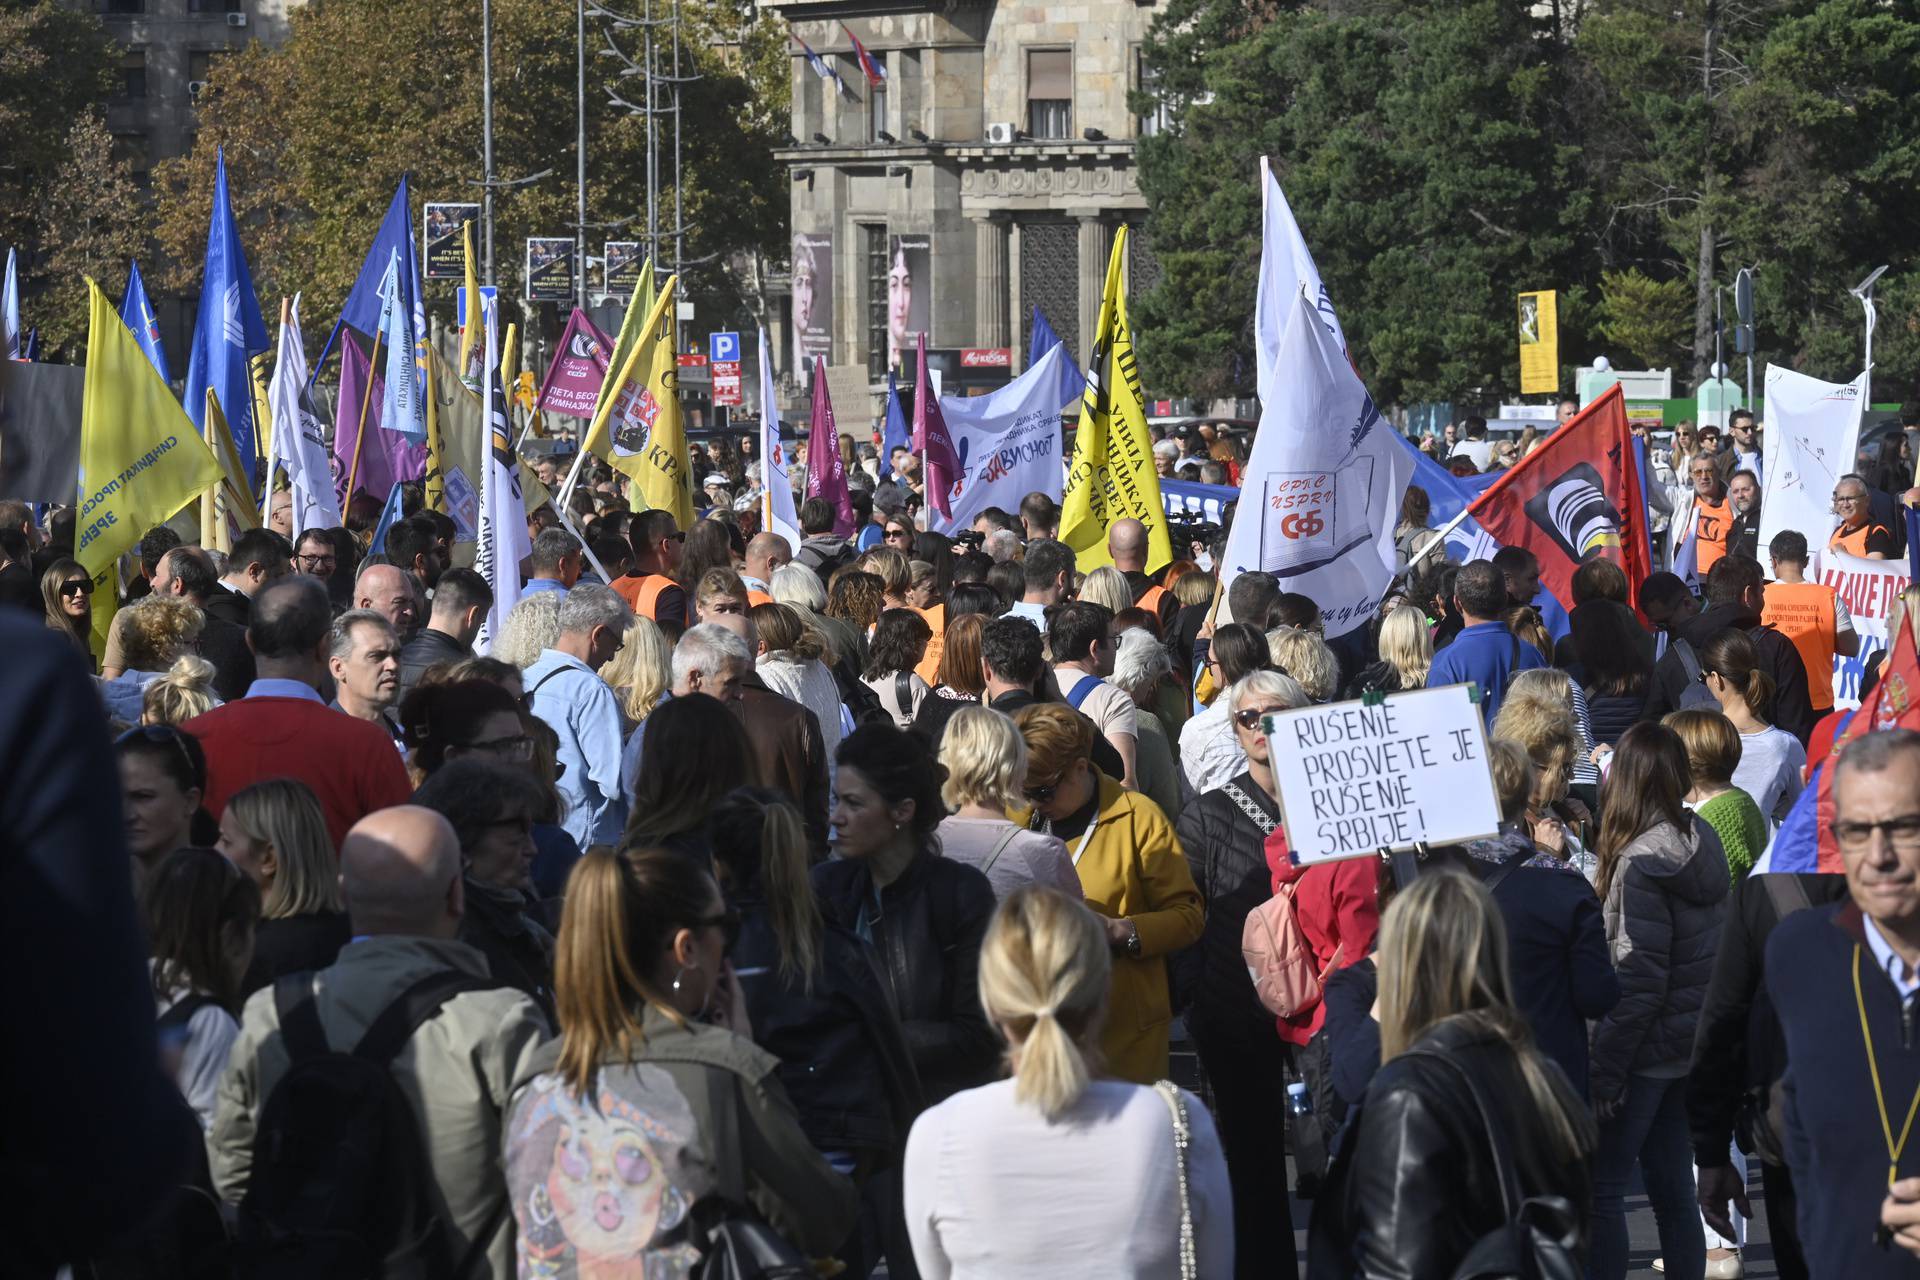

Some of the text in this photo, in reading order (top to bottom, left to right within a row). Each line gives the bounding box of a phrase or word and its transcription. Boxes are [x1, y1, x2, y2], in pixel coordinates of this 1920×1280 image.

[716, 336, 733, 359] P
[549, 385, 599, 401] ПЕТА БЕОГ
[1014, 410, 1042, 427] ДИКАТ
[1109, 402, 1145, 473] УНИЈА
[980, 432, 1055, 484] ЗАВИСНОСТ
[1302, 728, 1477, 788] PROSVETE JE
